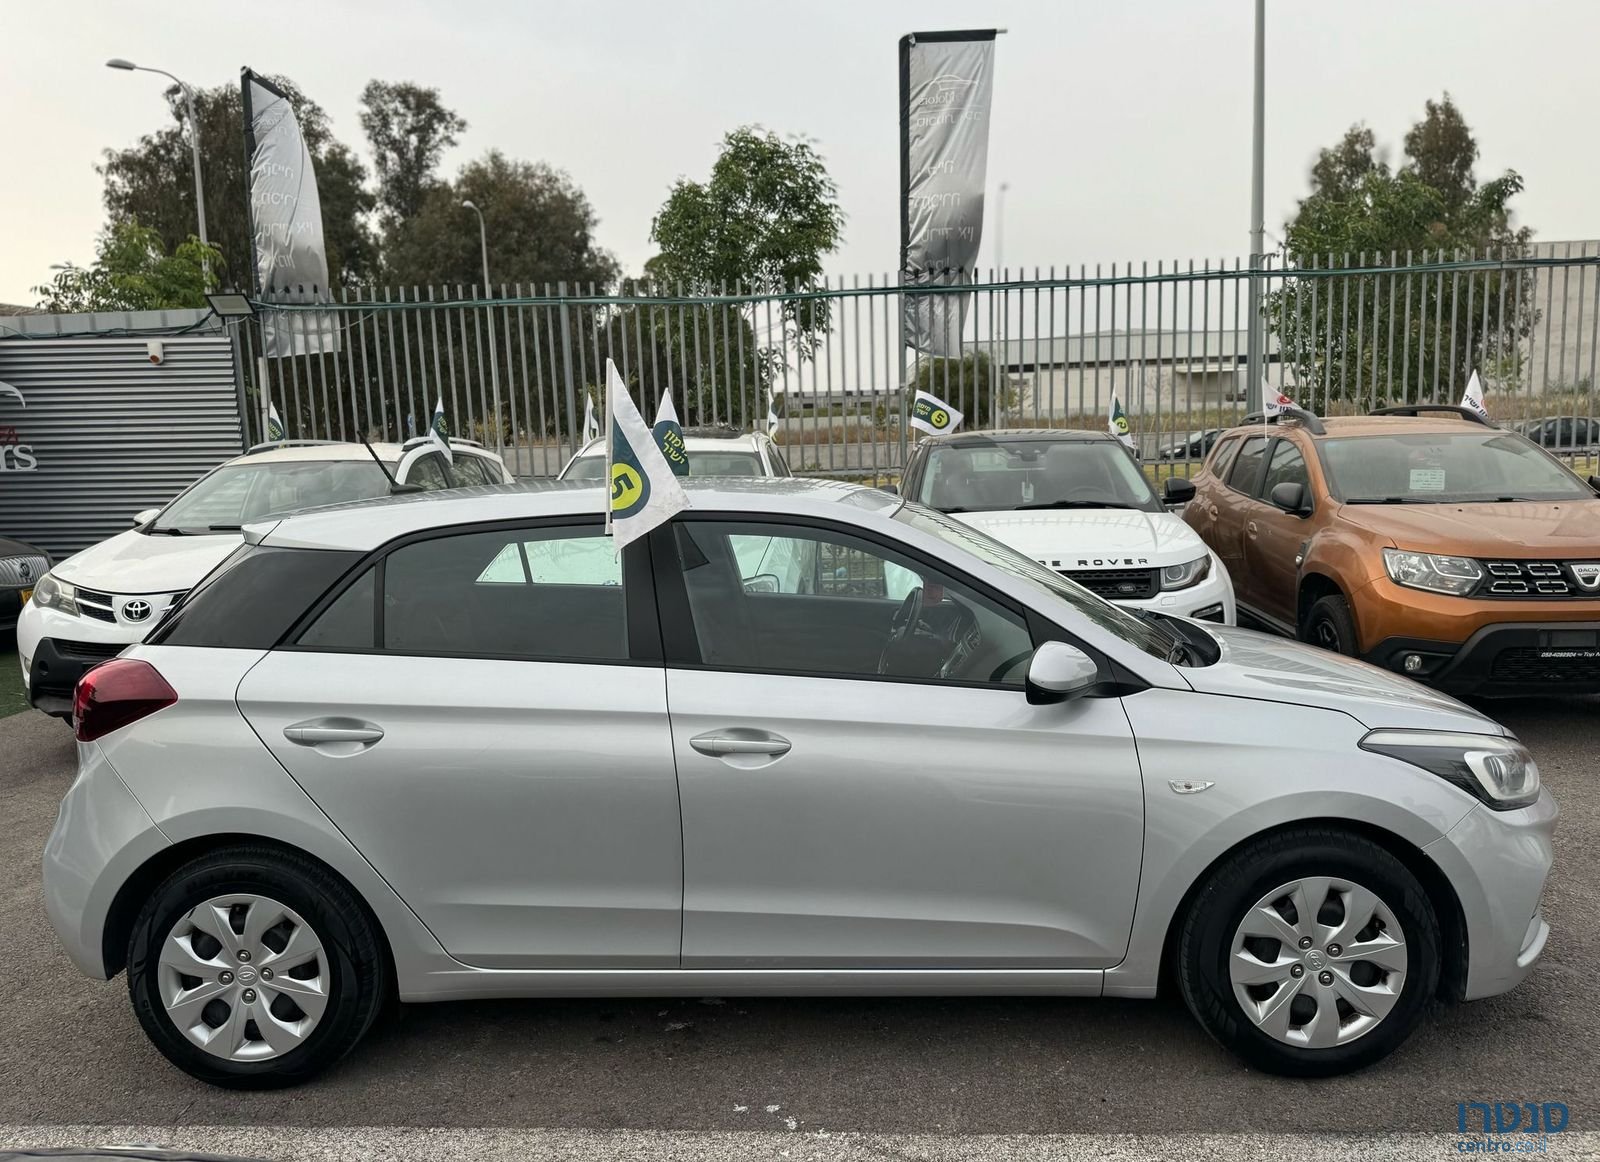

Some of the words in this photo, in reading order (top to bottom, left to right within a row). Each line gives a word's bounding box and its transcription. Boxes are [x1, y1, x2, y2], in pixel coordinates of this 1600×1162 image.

[935, 413, 945, 424] 5
[663, 429, 688, 457] ימון
[663, 442, 685, 465] ישיר
[612, 472, 635, 501] 5
[1078, 558, 1148, 566] ROVER
